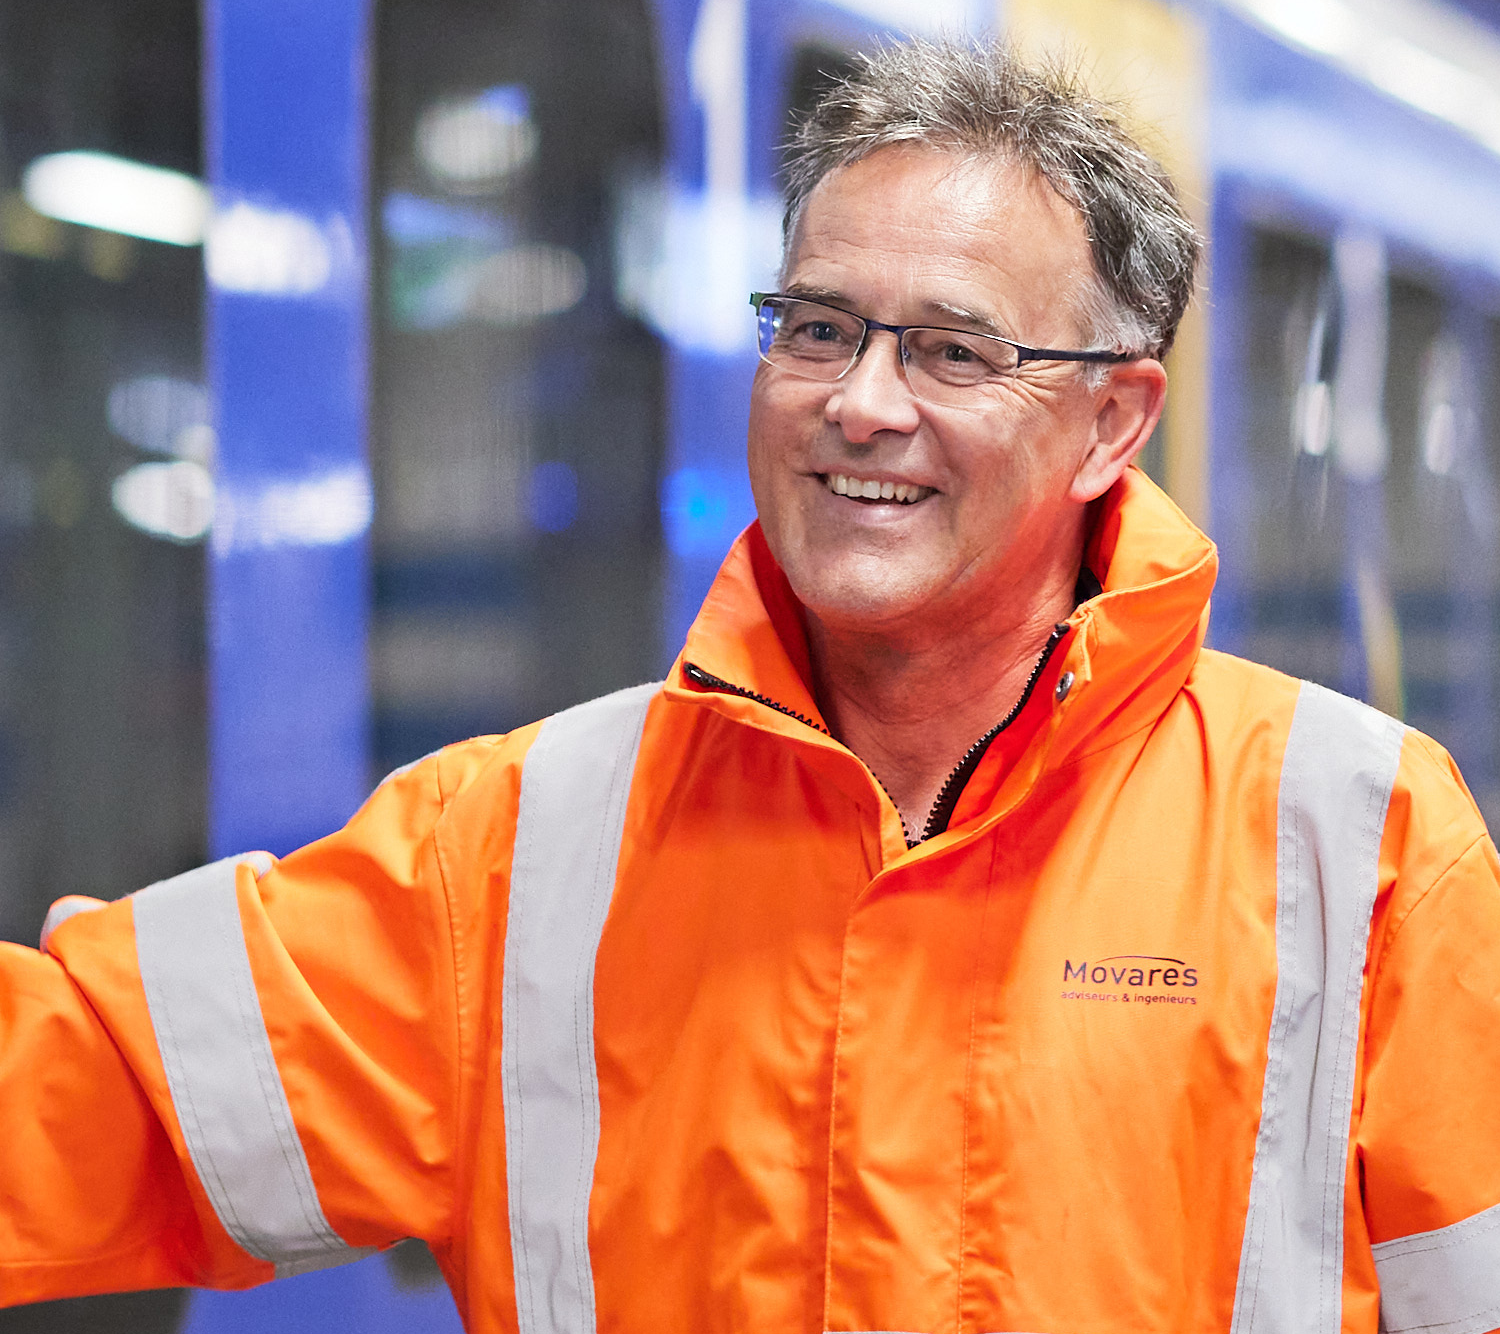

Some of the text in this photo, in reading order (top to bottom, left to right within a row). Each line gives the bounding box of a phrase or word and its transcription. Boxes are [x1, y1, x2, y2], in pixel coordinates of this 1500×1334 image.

[1064, 959, 1198, 987] Movares
[1061, 990, 1197, 1005] adviseurs & ingenieurs
